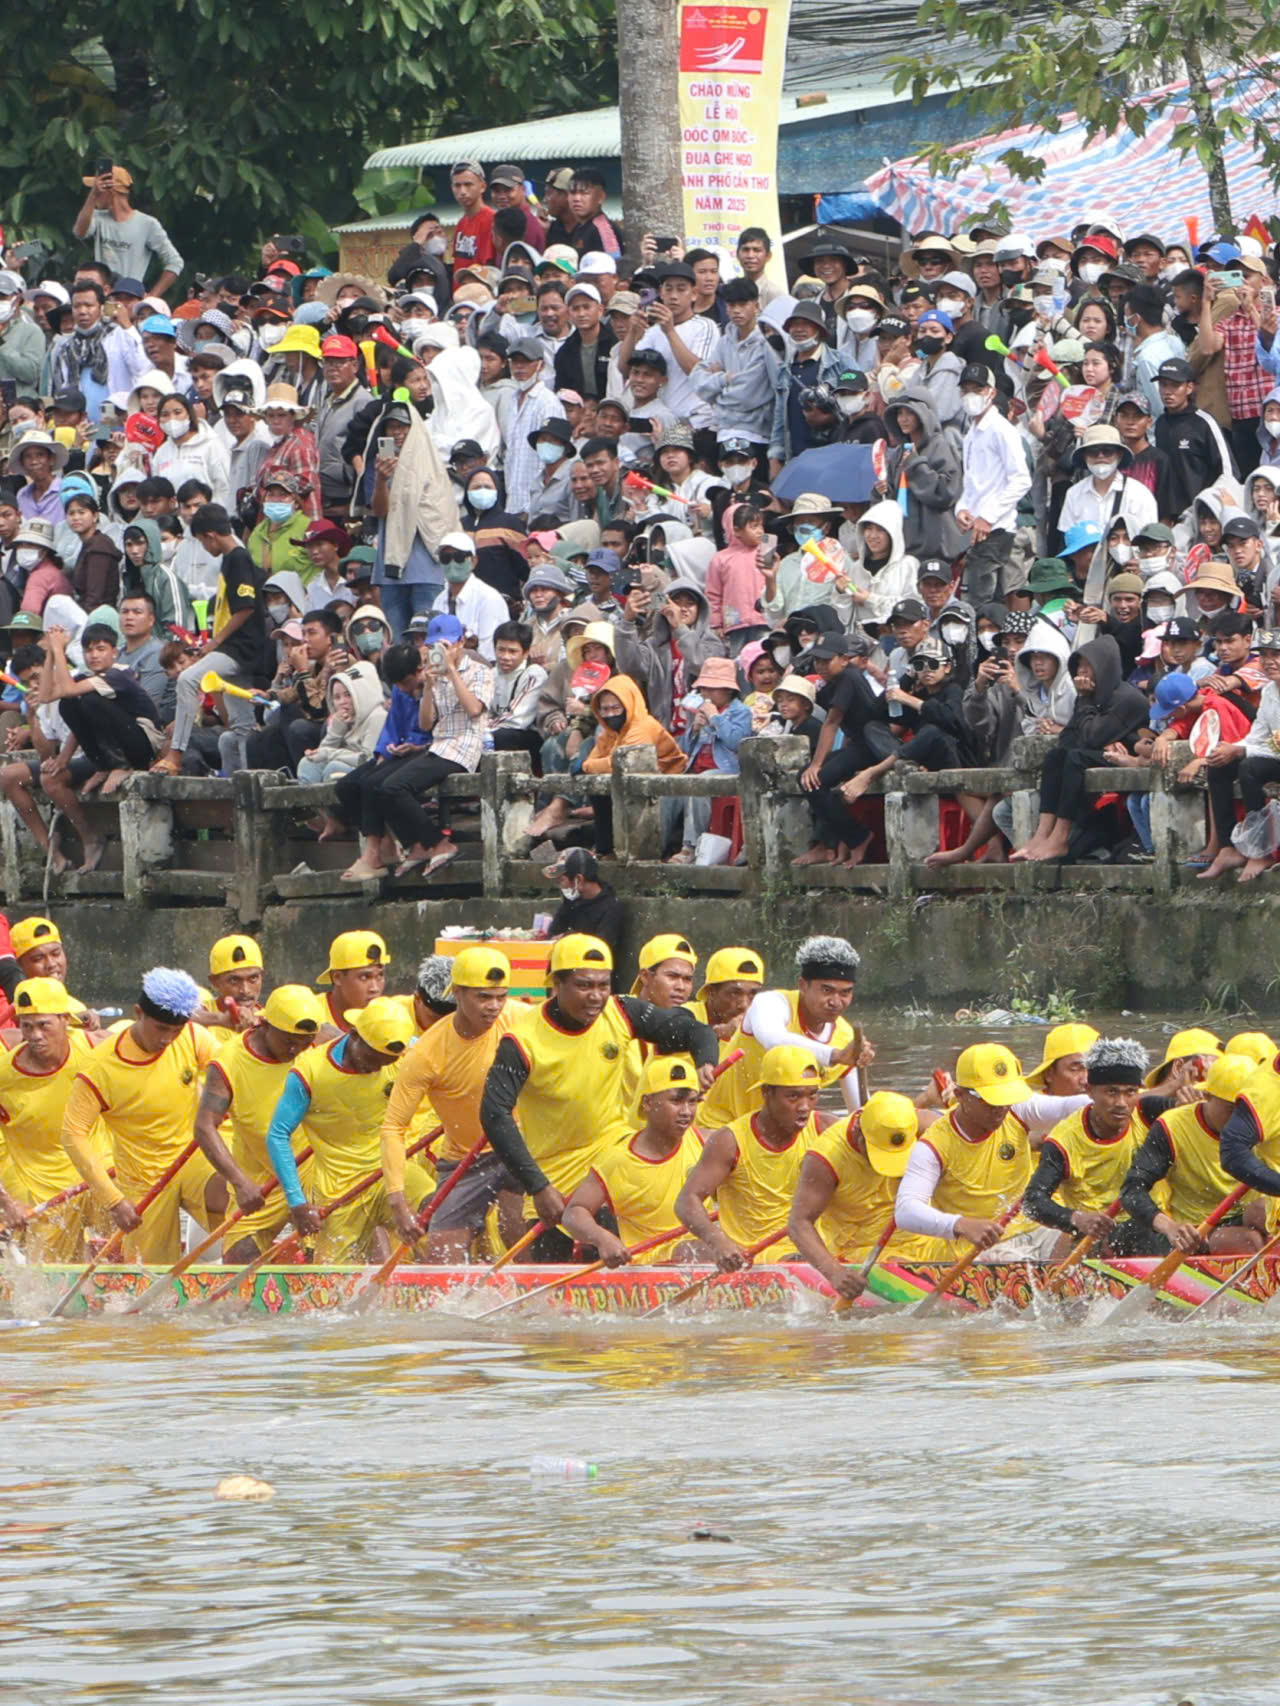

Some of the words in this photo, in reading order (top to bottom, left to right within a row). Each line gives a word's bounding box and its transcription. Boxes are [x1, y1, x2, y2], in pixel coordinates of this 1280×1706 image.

[705, 100, 721, 120] LỄ
[712, 129, 730, 143] OM
[685, 152, 711, 166] ĐUA
[714, 151, 735, 166] GHE
